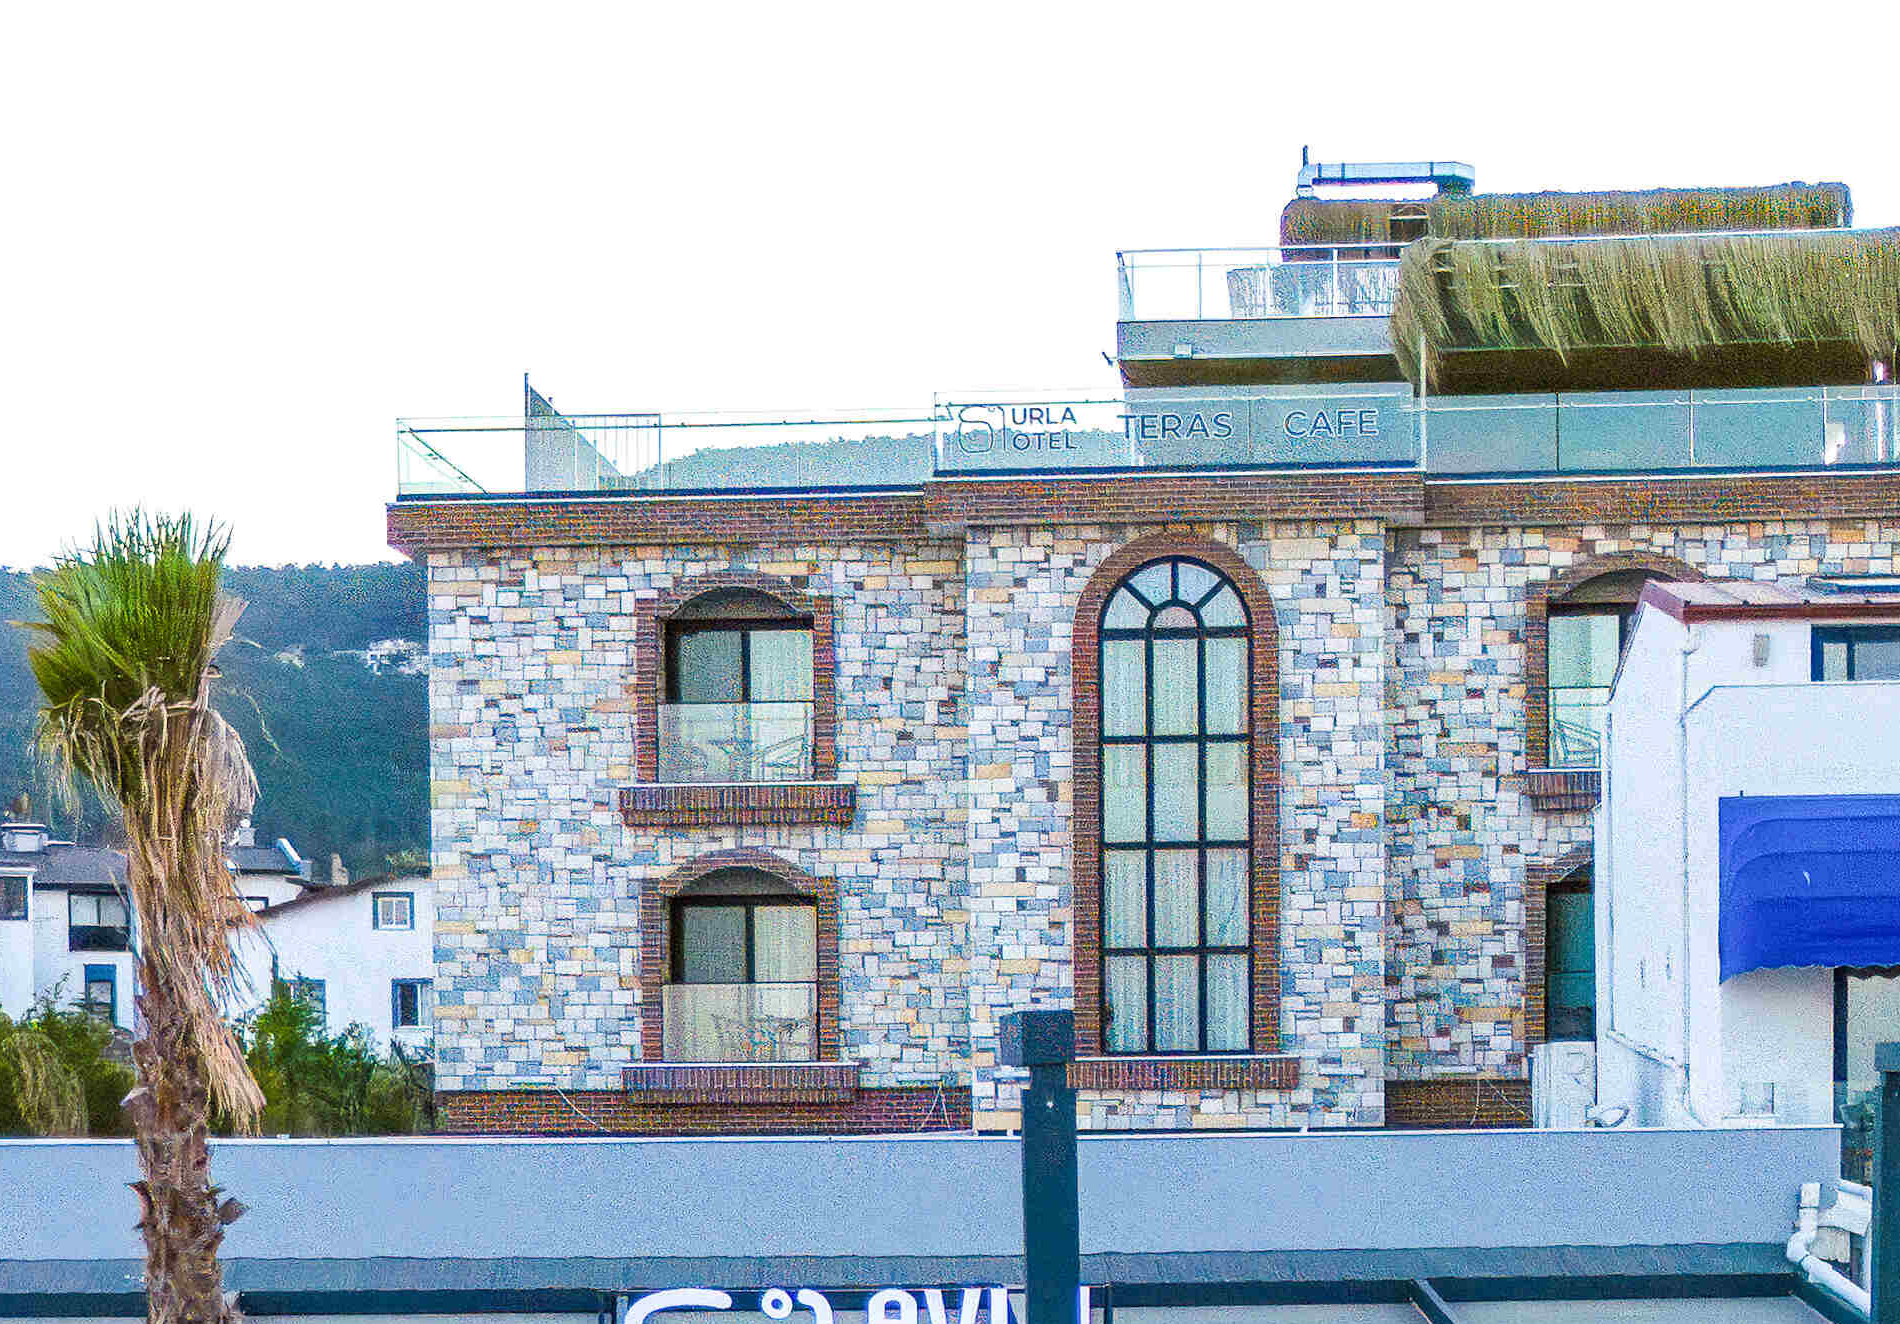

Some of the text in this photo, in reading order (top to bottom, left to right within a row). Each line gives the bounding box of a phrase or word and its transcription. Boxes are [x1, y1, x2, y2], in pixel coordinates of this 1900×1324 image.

[1011, 406, 1078, 426] URLA
[1116, 409, 1379, 441] TERAS CAFE
[1012, 431, 1078, 451] OTEL
